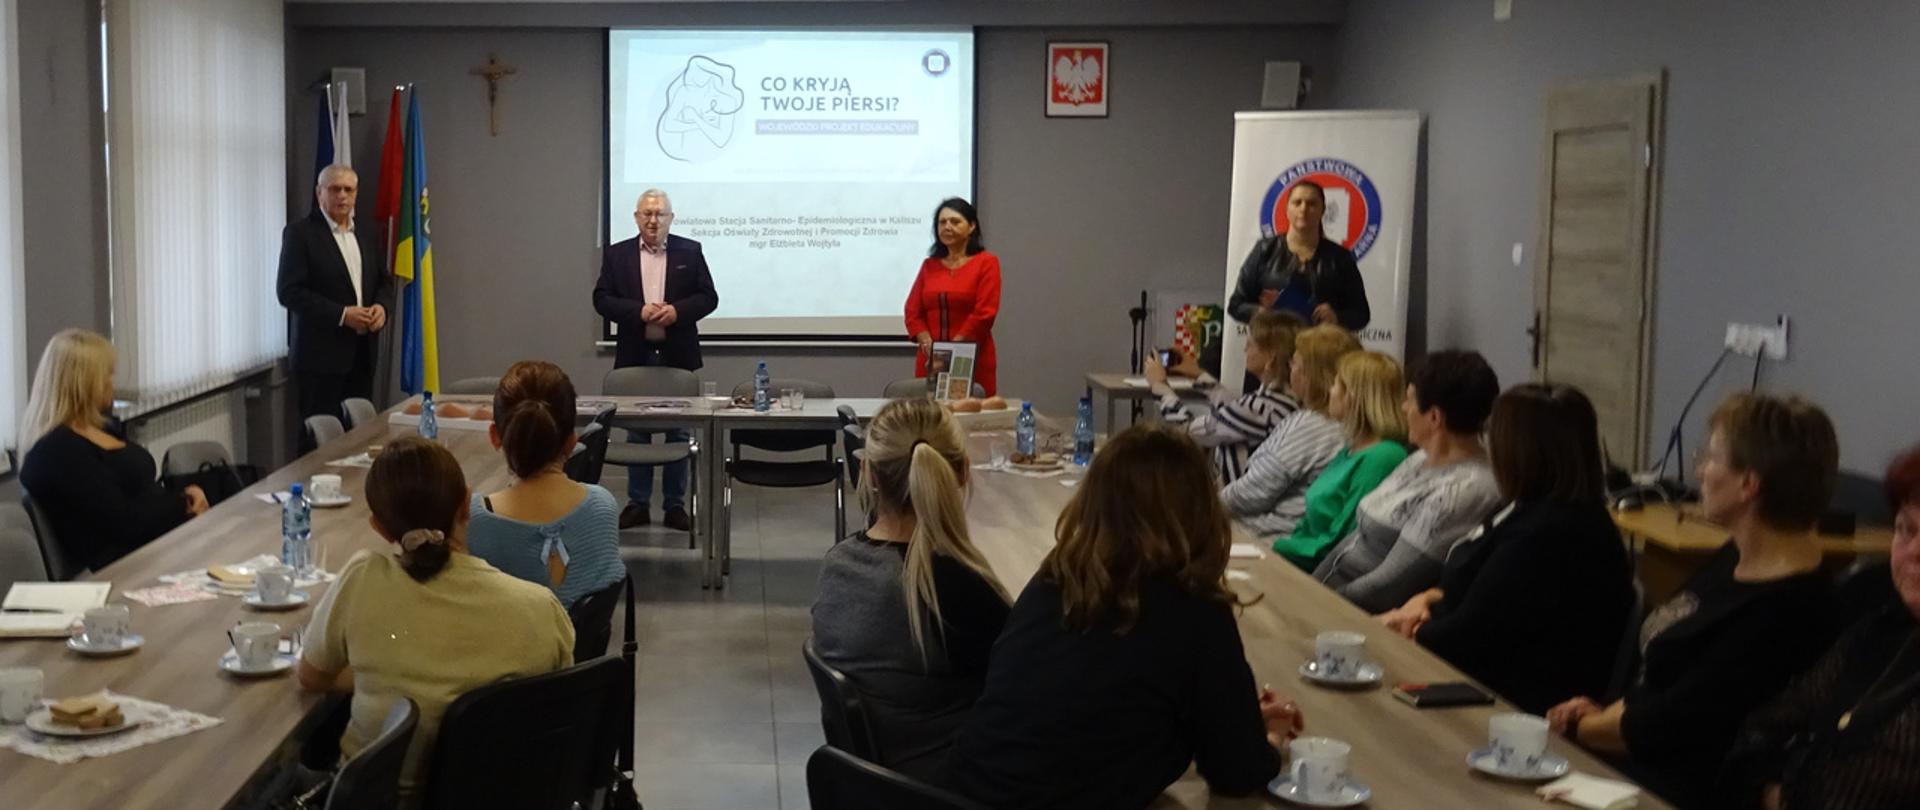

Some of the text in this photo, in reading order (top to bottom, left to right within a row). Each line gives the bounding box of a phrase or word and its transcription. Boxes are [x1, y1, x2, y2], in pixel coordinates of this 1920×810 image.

[761, 77, 852, 96] CO KRYJĄ
[760, 96, 900, 112] TWOJE PIERSI?
[673, 216, 717, 225] owiatowa
[720, 216, 746, 226] Stacja
[798, 216, 877, 226] Epidemiologiczna
[889, 216, 922, 225] Kaliszu
[691, 228, 720, 237] Sekcja
[761, 227, 813, 237] Zdrowotnej
[820, 227, 860, 237] Promocji
[862, 227, 899, 236] Zdrowia
